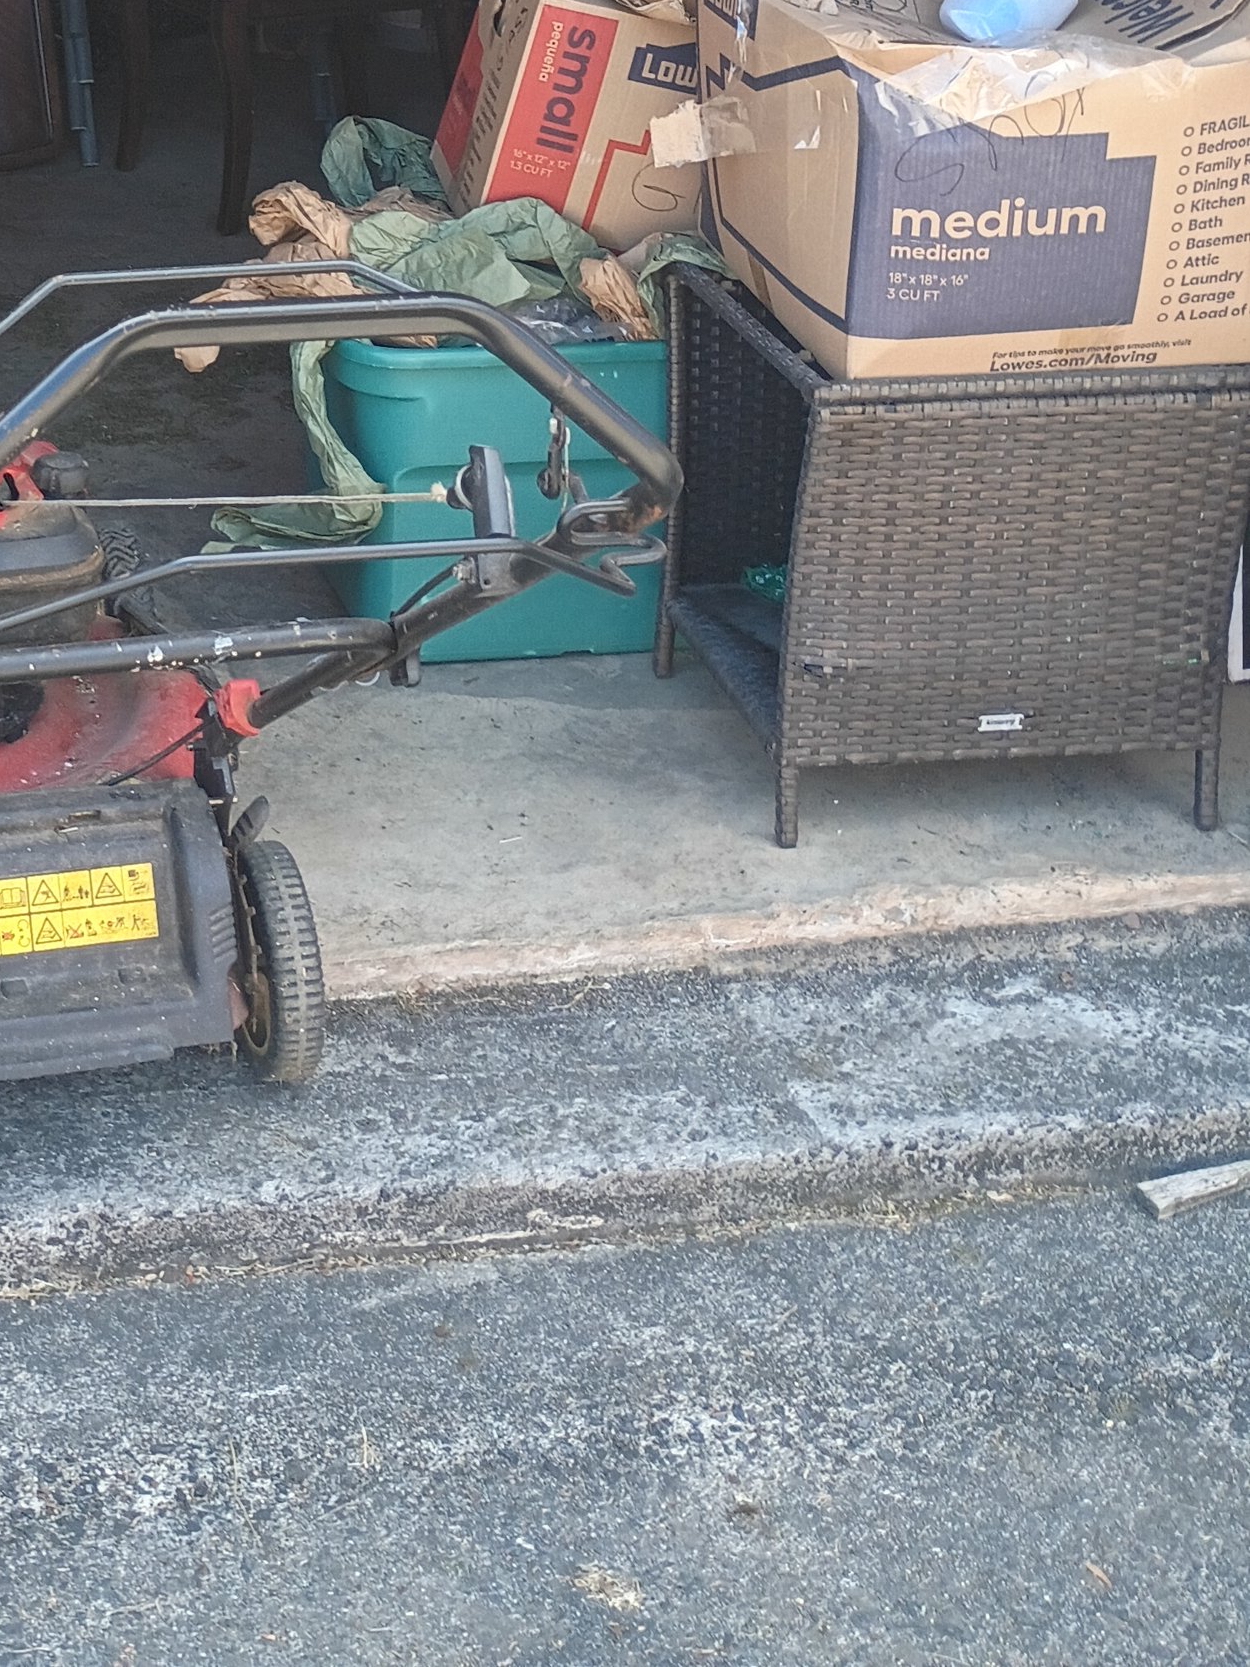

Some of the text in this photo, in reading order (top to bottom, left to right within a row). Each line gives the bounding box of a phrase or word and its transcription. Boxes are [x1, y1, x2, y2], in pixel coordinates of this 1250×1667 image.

[538, 20, 564, 83] pequeña
[535, 25, 596, 154] small
[1200, 115, 1250, 136] FRAGIL
[523, 163, 539, 175] CU
[539, 167, 553, 179] FT
[1195, 154, 1241, 174] Family
[1193, 176, 1239, 194] Dining
[1190, 194, 1246, 213] Kitchen
[891, 197, 1106, 239] medium
[1188, 216, 1223, 232] Bath
[1186, 232, 1250, 250] Basemen
[890, 243, 991, 262] mediana
[1183, 253, 1220, 269] Attic
[889, 272, 969, 286] 18" x 18" x 16"
[1180, 269, 1244, 287] Laundry
[887, 288, 940, 301] 3 CU FT
[1178, 290, 1236, 305] Garage
[1174, 303, 1249, 322] A Load of
[992, 350, 1007, 359] For
[1008, 350, 1025, 359] tips
[1027, 349, 1037, 357] to
[1038, 347, 1064, 356] make
[1065, 346, 1087, 355] your
[1087, 344, 1111, 353] move
[1112, 343, 1125, 352] go
[1171, 338, 1192, 347] visit
[990, 350, 1158, 373] Lowes.com/Moving
